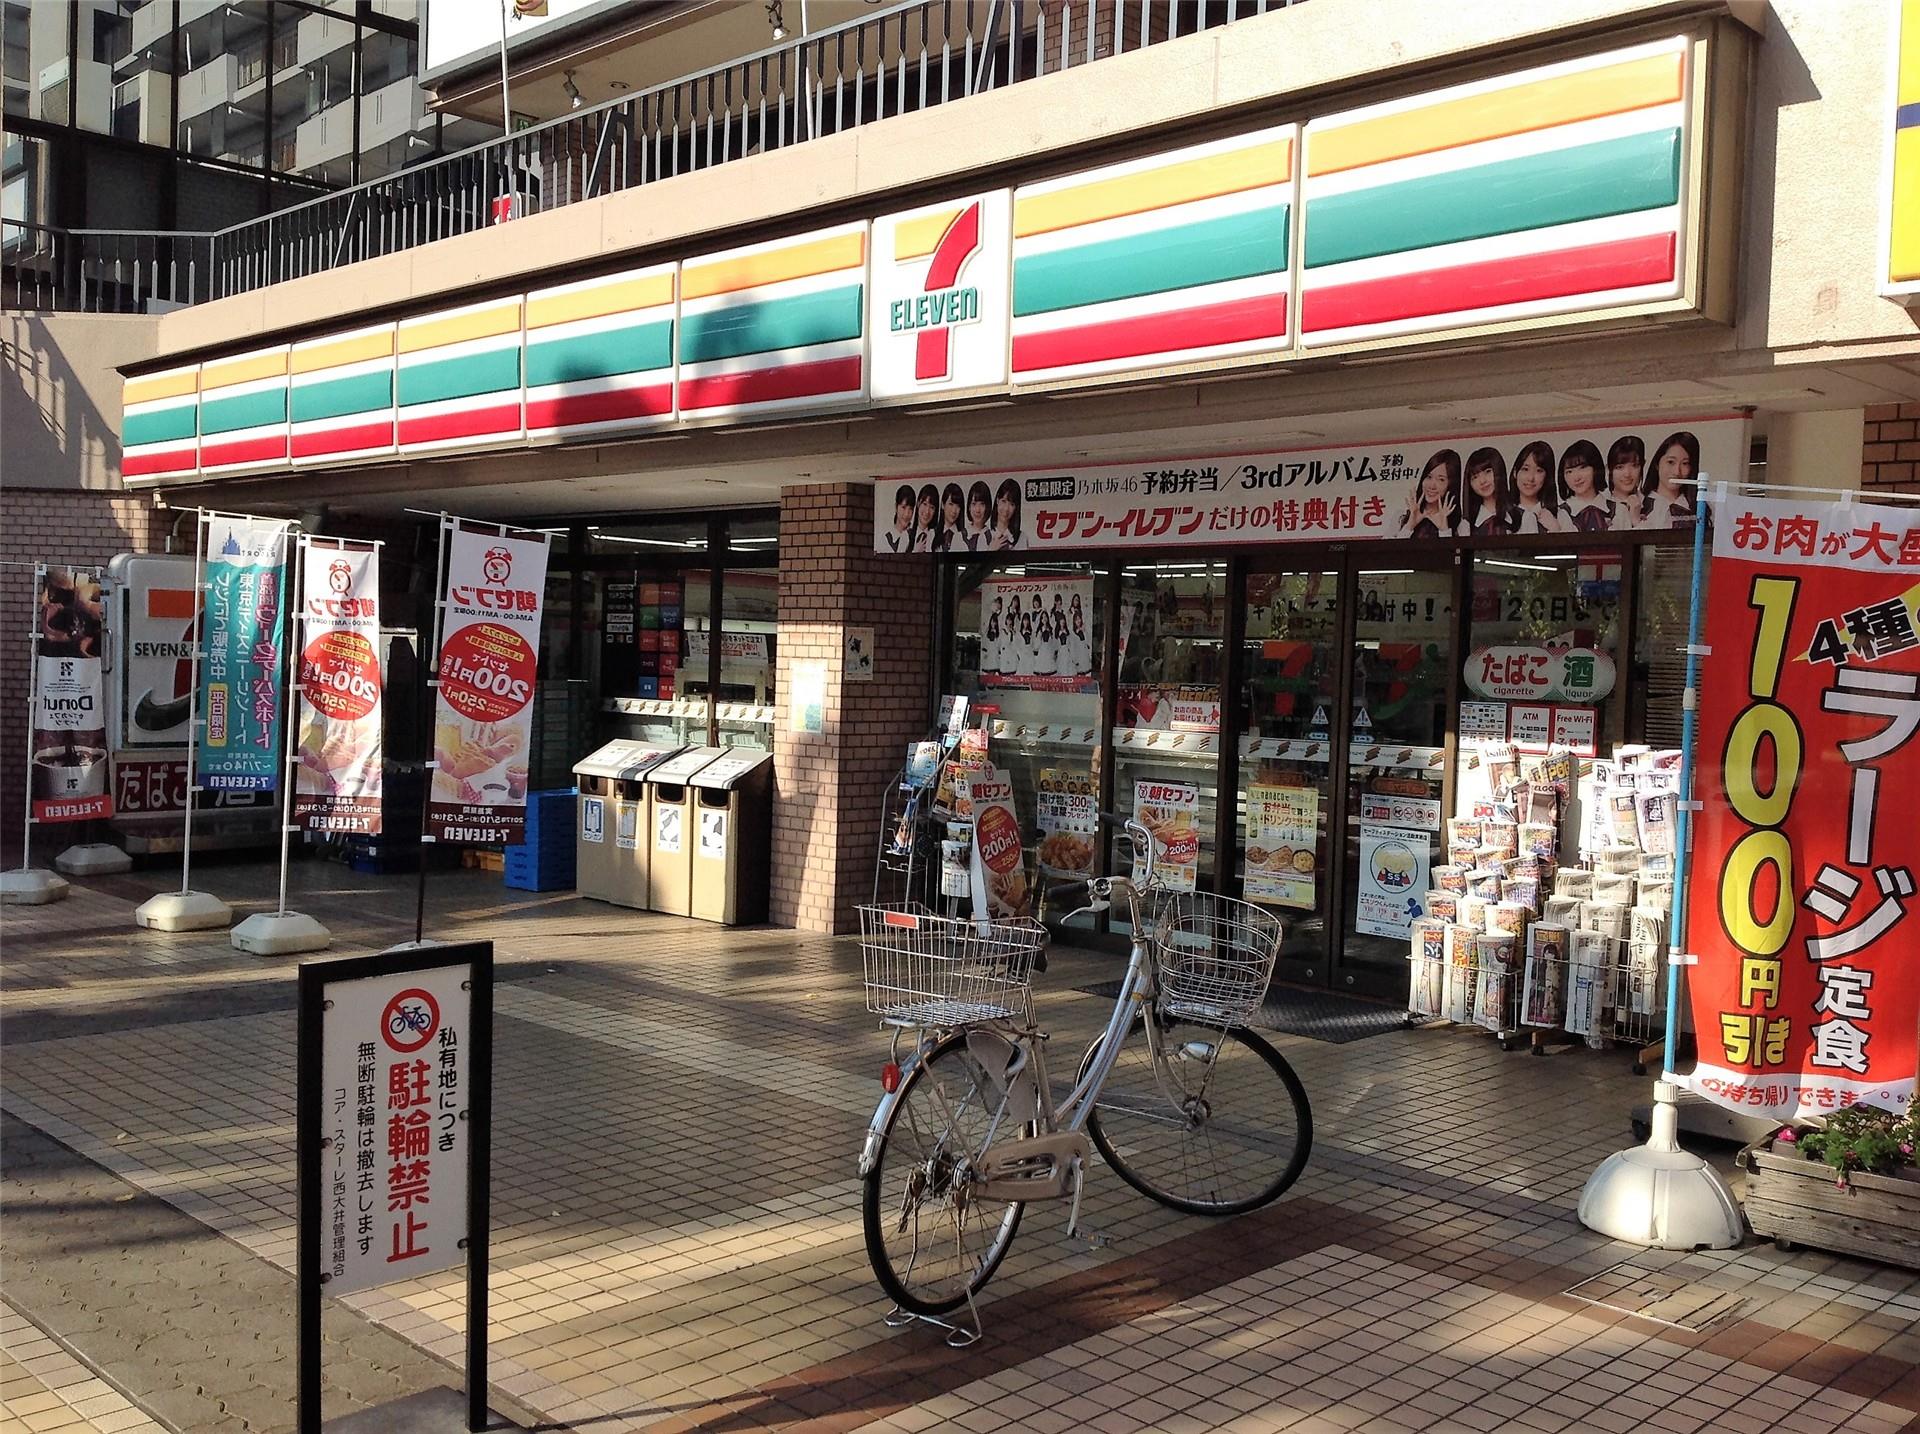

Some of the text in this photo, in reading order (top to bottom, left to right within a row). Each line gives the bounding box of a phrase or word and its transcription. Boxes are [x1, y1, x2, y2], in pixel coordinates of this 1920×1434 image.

[1381, 454, 1404, 467] 予約
[1026, 480, 1075, 499] 数量限定
[1808, 598, 1920, 665] 4種
[1481, 653, 1595, 687] たばこ 酒
[1493, 687, 1593, 699] cigarette liquor
[1522, 712, 1539, 721] ATM
[1557, 714, 1593, 724] Free Wi-Fi
[971, 783, 1011, 799] 朝セブン
[1149, 786, 1195, 803] 朝セブン
[1387, 872, 1400, 881] SS
[437, 1026, 458, 1152] 私有地につき
[356, 1041, 376, 1256] 無断駐輪は撤去します
[386, 1058, 432, 1264] 駐輪禁止
